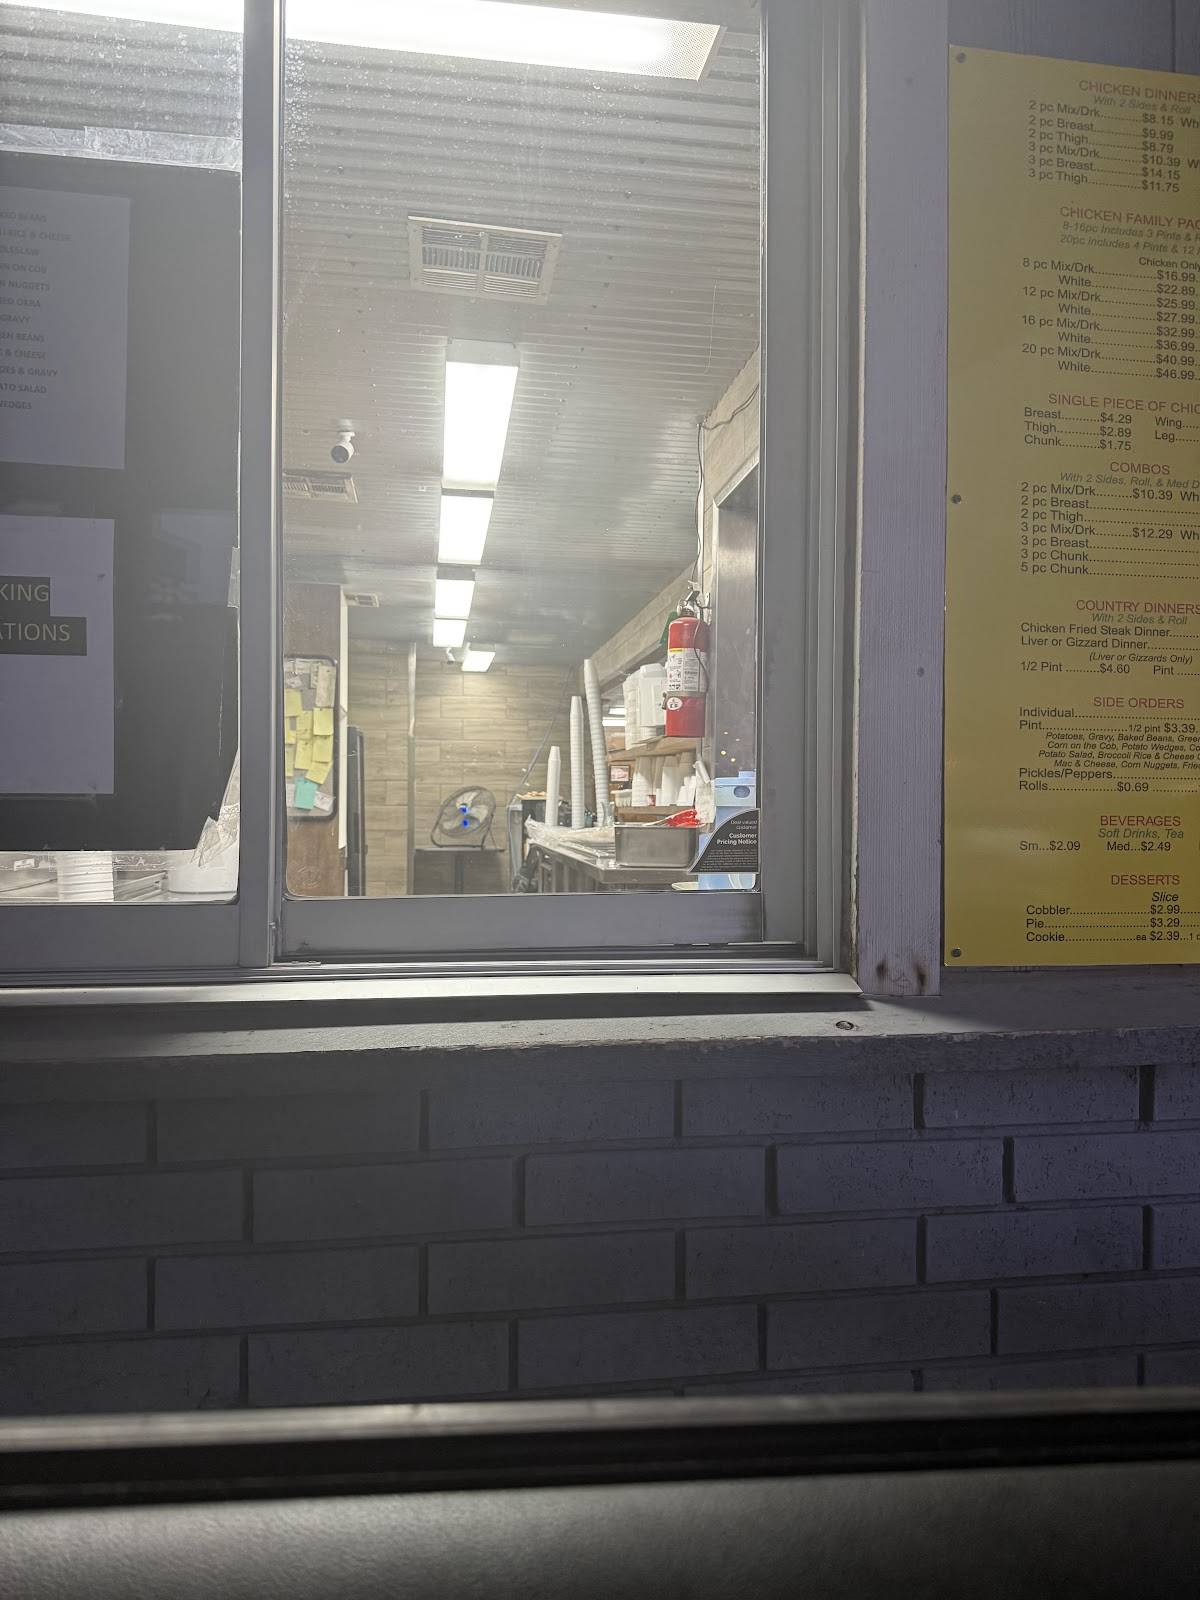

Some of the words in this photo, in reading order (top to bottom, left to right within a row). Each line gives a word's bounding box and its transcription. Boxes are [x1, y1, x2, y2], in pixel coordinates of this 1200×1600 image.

[1079, 79, 1141, 97] CHICKEN
[1040, 103, 1054, 114] pc
[1057, 102, 1101, 118] Mix/Drk
[1040, 118, 1054, 129] pc
[1057, 117, 1095, 132] Breast
[1142, 127, 1175, 141] $9.99
[1040, 132, 1054, 142] pc
[1057, 131, 1089, 146] Thigh
[1142, 140, 1175, 155] $8.79
[1040, 145, 1054, 155] pc
[1056, 145, 1101, 159] Mix/Drk
[1142, 153, 1181, 168] $10.39
[1040, 158, 1054, 168] pc
[1056, 157, 1095, 172] Breast
[1142, 166, 1181, 181] $14.15
[1039, 172, 1054, 182] pc
[1056, 170, 1089, 185] Thigh
[1141, 179, 1181, 193] $11.75
[1060, 206, 1122, 222] CHICKEN
[1128, 211, 1173, 228] FAMILY
[1139, 256, 1178, 269] Chicken
[1033, 260, 1048, 271] pc
[1051, 259, 1096, 274] Mix/Drk
[1157, 269, 1196, 282] $16.99
[1058, 273, 1092, 287] White
[1156, 282, 1196, 297] $22.89
[1023, 285, 1037, 297] 12
[1040, 288, 1055, 300] pc
[1057, 287, 1100, 302] Mix/Drk
[1156, 296, 1196, 311] $25.99
[1058, 302, 1092, 316] White
[1156, 310, 1196, 324] $27.99
[1022, 314, 1036, 326] 16
[1039, 318, 1054, 328] pc
[1056, 317, 1101, 331] Mix/Drk
[1156, 325, 1196, 339] $32.99
[1058, 330, 1092, 344] White
[1156, 338, 1196, 353] $36.99
[1021, 342, 1038, 354] 20
[1040, 346, 1055, 357] pc
[1057, 346, 1101, 360] Mix/Drk
[1155, 353, 1195, 367] $40.99
[1058, 359, 1091, 373] White
[1155, 367, 1195, 381] $46.99
[1048, 393, 1100, 408] SINGLE
[1103, 397, 1145, 411] PIECE
[1147, 400, 1168, 412] OF
[1023, 406, 1061, 420] Breast
[1100, 411, 1132, 425] $4.29
[1155, 415, 1183, 430] Wing
[1024, 420, 1057, 435] Thigh
[1099, 425, 1132, 439] $2.89
[1154, 429, 1175, 443] Leg
[1024, 433, 1062, 446] Chunk
[1099, 439, 1132, 451] $1.75
[1110, 461, 1170, 476] COMBOS
[1032, 484, 1047, 495] pc
[1050, 483, 1096, 496] Mix/Drk
[1132, 488, 1173, 500] $10.39
[1021, 495, 1029, 506] 2
[1032, 497, 1047, 508] pc
[1050, 496, 1089, 508] Breast
[1021, 509, 1029, 519] 2
[1032, 510, 1047, 521] pc
[1050, 510, 1084, 523] Thigh
[1021, 521, 1029, 532] 3
[1032, 524, 1047, 534] pc
[1050, 523, 1096, 536] Mix/Drk
[1132, 527, 1173, 539] $12.29
[1021, 535, 1029, 545] 3
[1032, 537, 1047, 548] pc
[1050, 536, 1089, 549] Breast
[1021, 548, 1029, 559] 3
[1032, 550, 1047, 561] pc
[1050, 549, 1089, 561] Chunk
[1032, 563, 1047, 575] pc
[1050, 562, 1089, 575] Chunk
[1076, 599, 1140, 612] COUNTRY
[0, 622, 71, 642] TIONS
[1021, 622, 1066, 634] Chicken
[1069, 623, 1097, 635] Fried
[1100, 624, 1131, 636] Steak
[1134, 625, 1170, 637] Dinner
[1021, 635, 1050, 647] Liver
[1051, 638, 1062, 647] or
[1066, 636, 1108, 649] Gizzard
[1111, 637, 1148, 650] Dinner
[1089, 651, 1115, 662] (Liver
[1129, 652, 1166, 663] Gizzards
[1170, 654, 1193, 666] Only)
[1020, 660, 1038, 672] 1/2
[1041, 661, 1063, 673] Pint
[1099, 662, 1131, 675] $4.60
[1153, 664, 1174, 676] Pint
[1093, 696, 1125, 708] SIDE
[1128, 697, 1185, 709] ORDERS
[1020, 706, 1075, 718] Individual
[1020, 719, 1041, 730] Pint
[1144, 724, 1160, 735] pint
[1164, 723, 1196, 734] $3.39
[1118, 733, 1145, 742] Baked
[1038, 749, 1066, 758] Potato
[1083, 741, 1097, 750] the
[1121, 742, 1148, 751] Potato
[1020, 768, 1113, 780] Pickles/Peppers
[1020, 780, 1048, 791] Rolls
[1116, 781, 1149, 792] $0.69
[1099, 815, 1182, 827] BEVERAGES
[1098, 828, 1120, 839] Soft
[1123, 828, 1160, 840] Drinks,
[1165, 828, 1185, 839] Tea
[1111, 874, 1181, 886] DESSERTS
[1151, 891, 1179, 902] Slice
[1026, 904, 1071, 916] Cobbler
[1150, 904, 1181, 915] $2.99
[1026, 918, 1044, 929] Pie
[1150, 917, 1181, 928] $3.29
[1026, 931, 1065, 942] Cookie
[1150, 930, 1180, 942] $2.39
